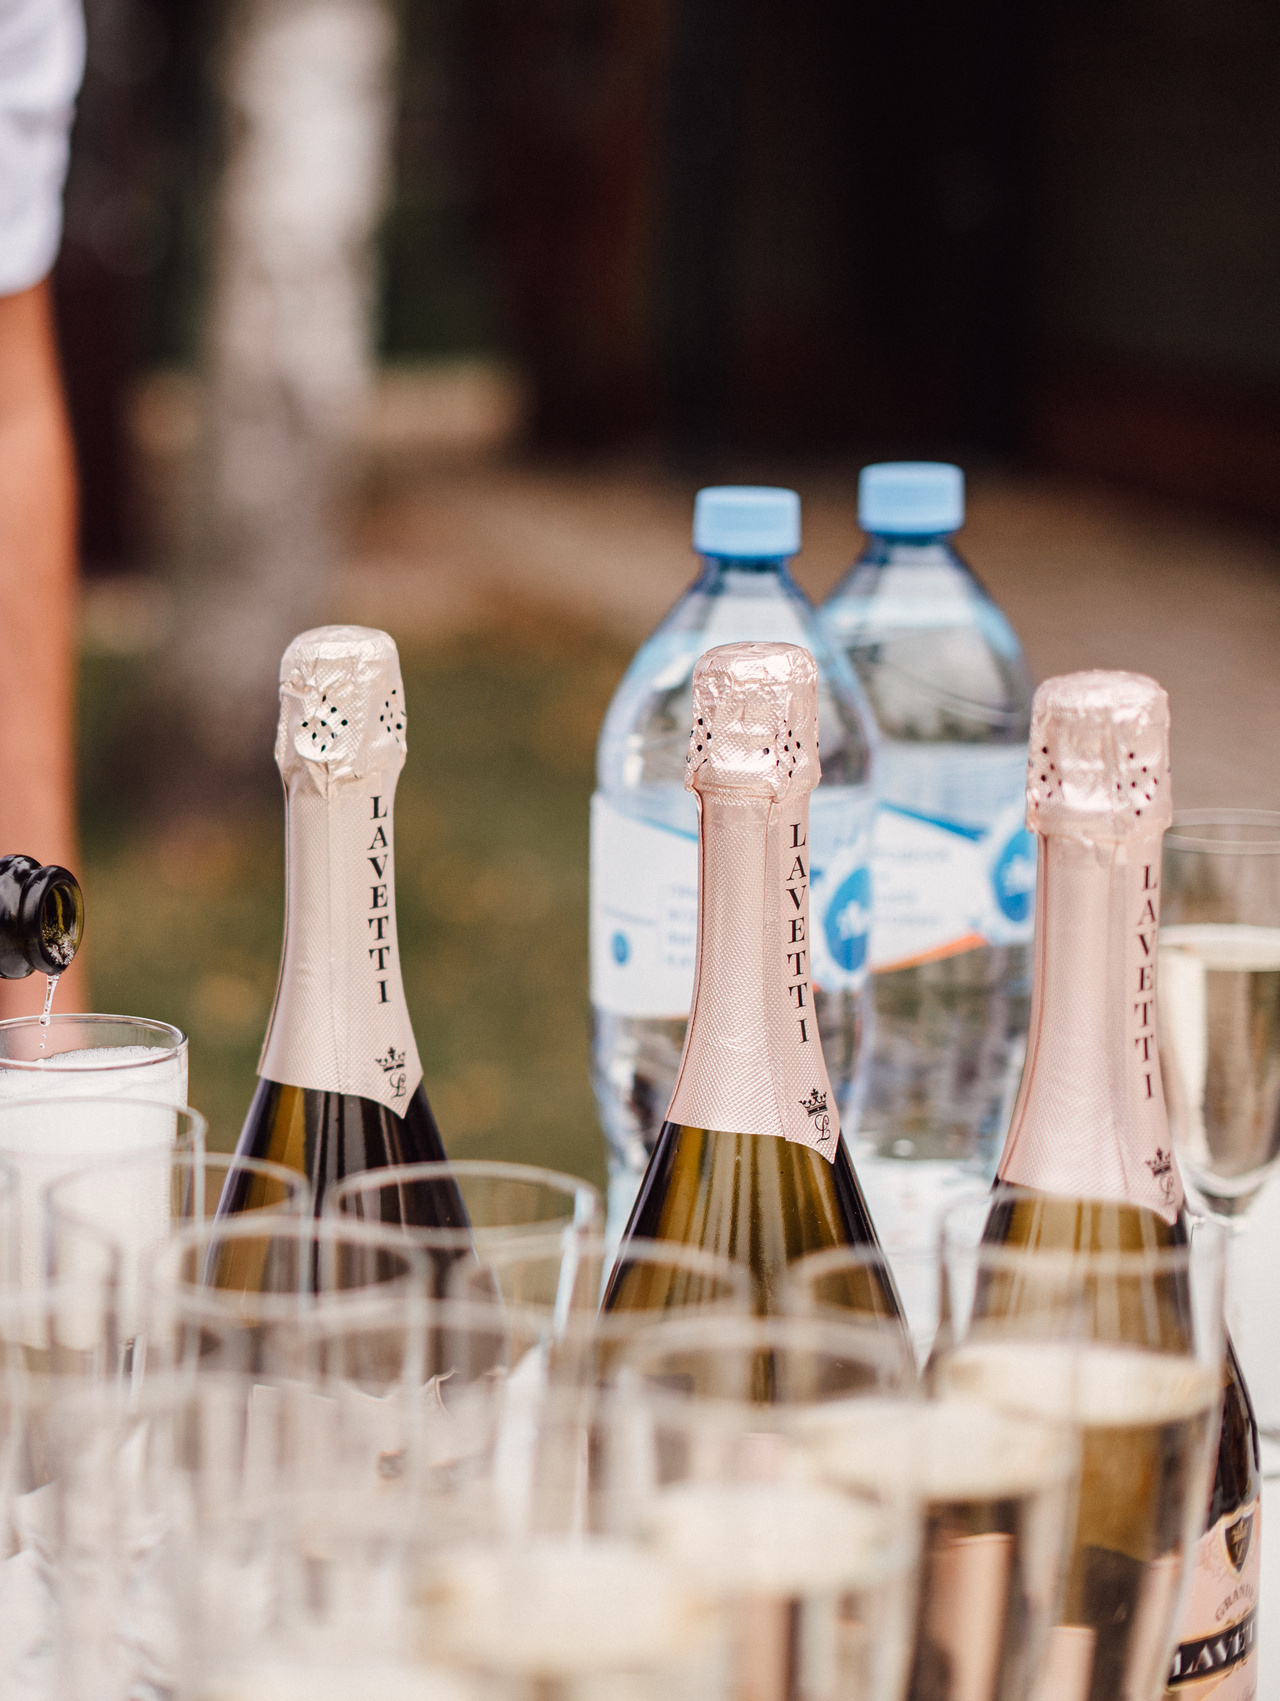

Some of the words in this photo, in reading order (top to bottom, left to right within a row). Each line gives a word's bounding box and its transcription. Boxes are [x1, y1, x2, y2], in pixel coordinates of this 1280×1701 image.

[367, 795, 390, 1005] LAVETTI
[786, 823, 810, 1044] LAVETTI
[1134, 865, 1158, 1100] LAVETTI
